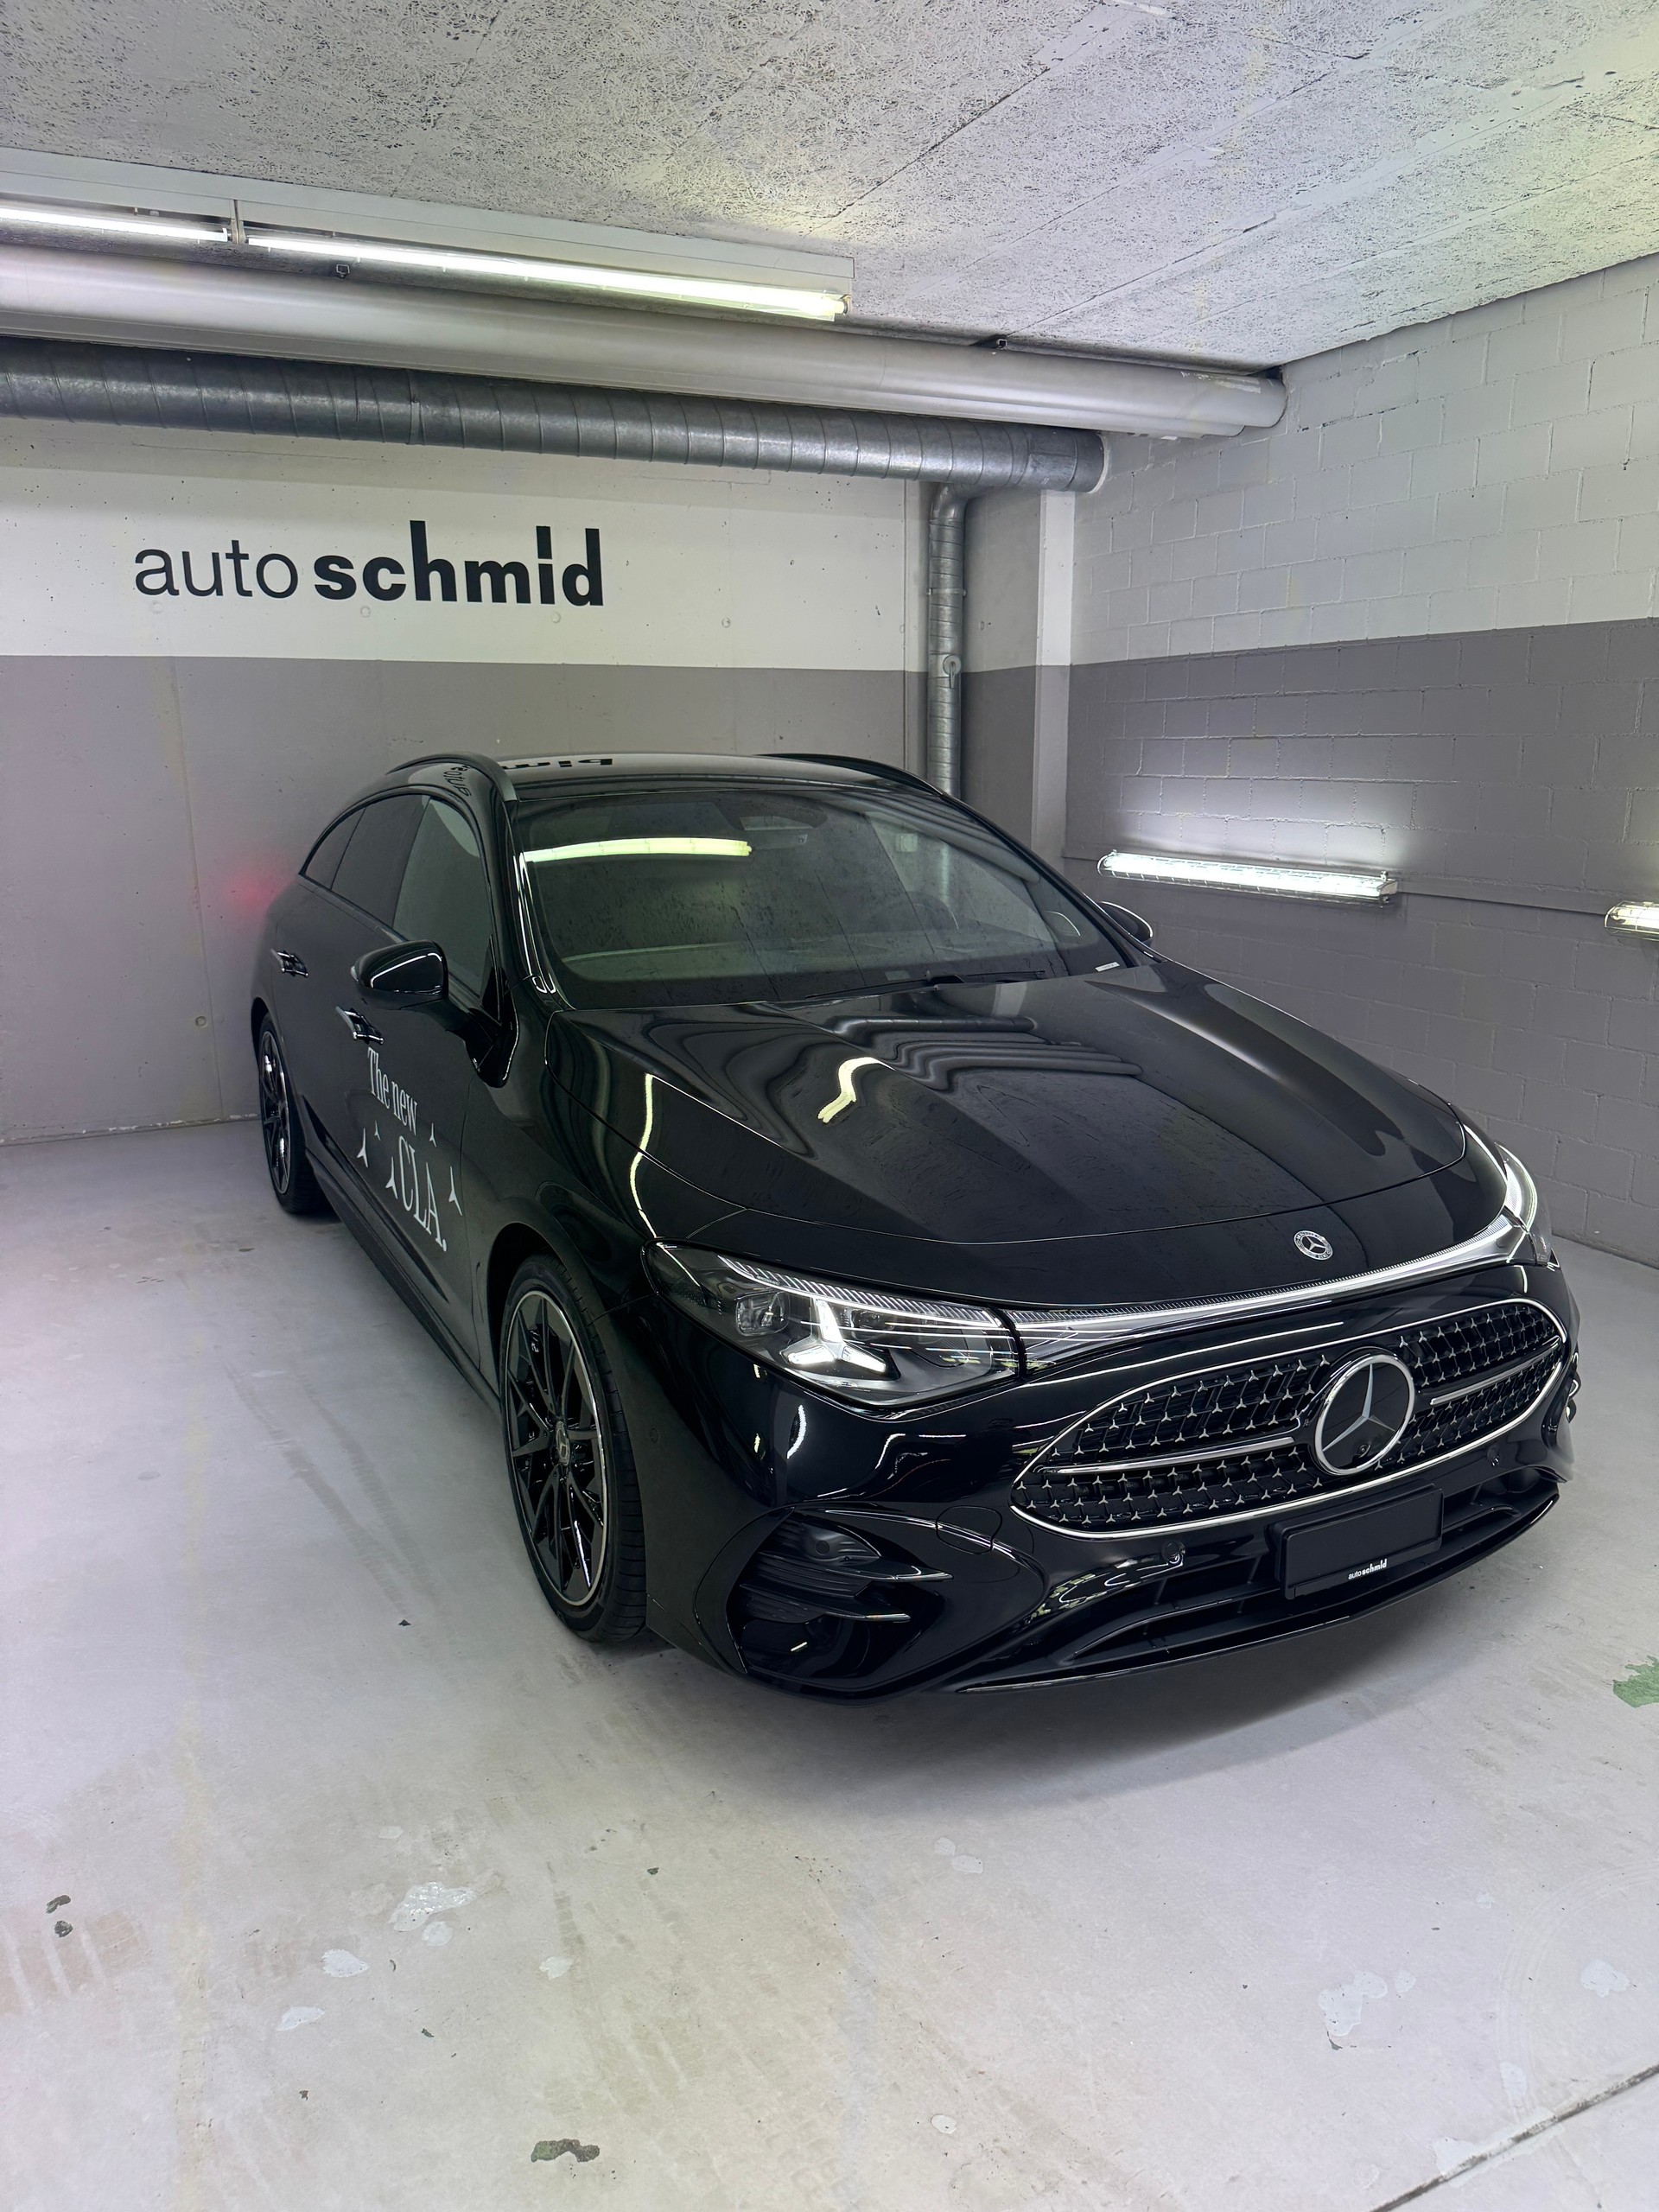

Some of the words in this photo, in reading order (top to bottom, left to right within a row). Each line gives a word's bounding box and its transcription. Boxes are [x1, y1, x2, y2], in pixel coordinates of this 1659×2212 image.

[135, 539, 299, 599] auto
[314, 519, 604, 607] schmid
[367, 1046, 390, 1109] The
[391, 1080, 418, 1136] new
